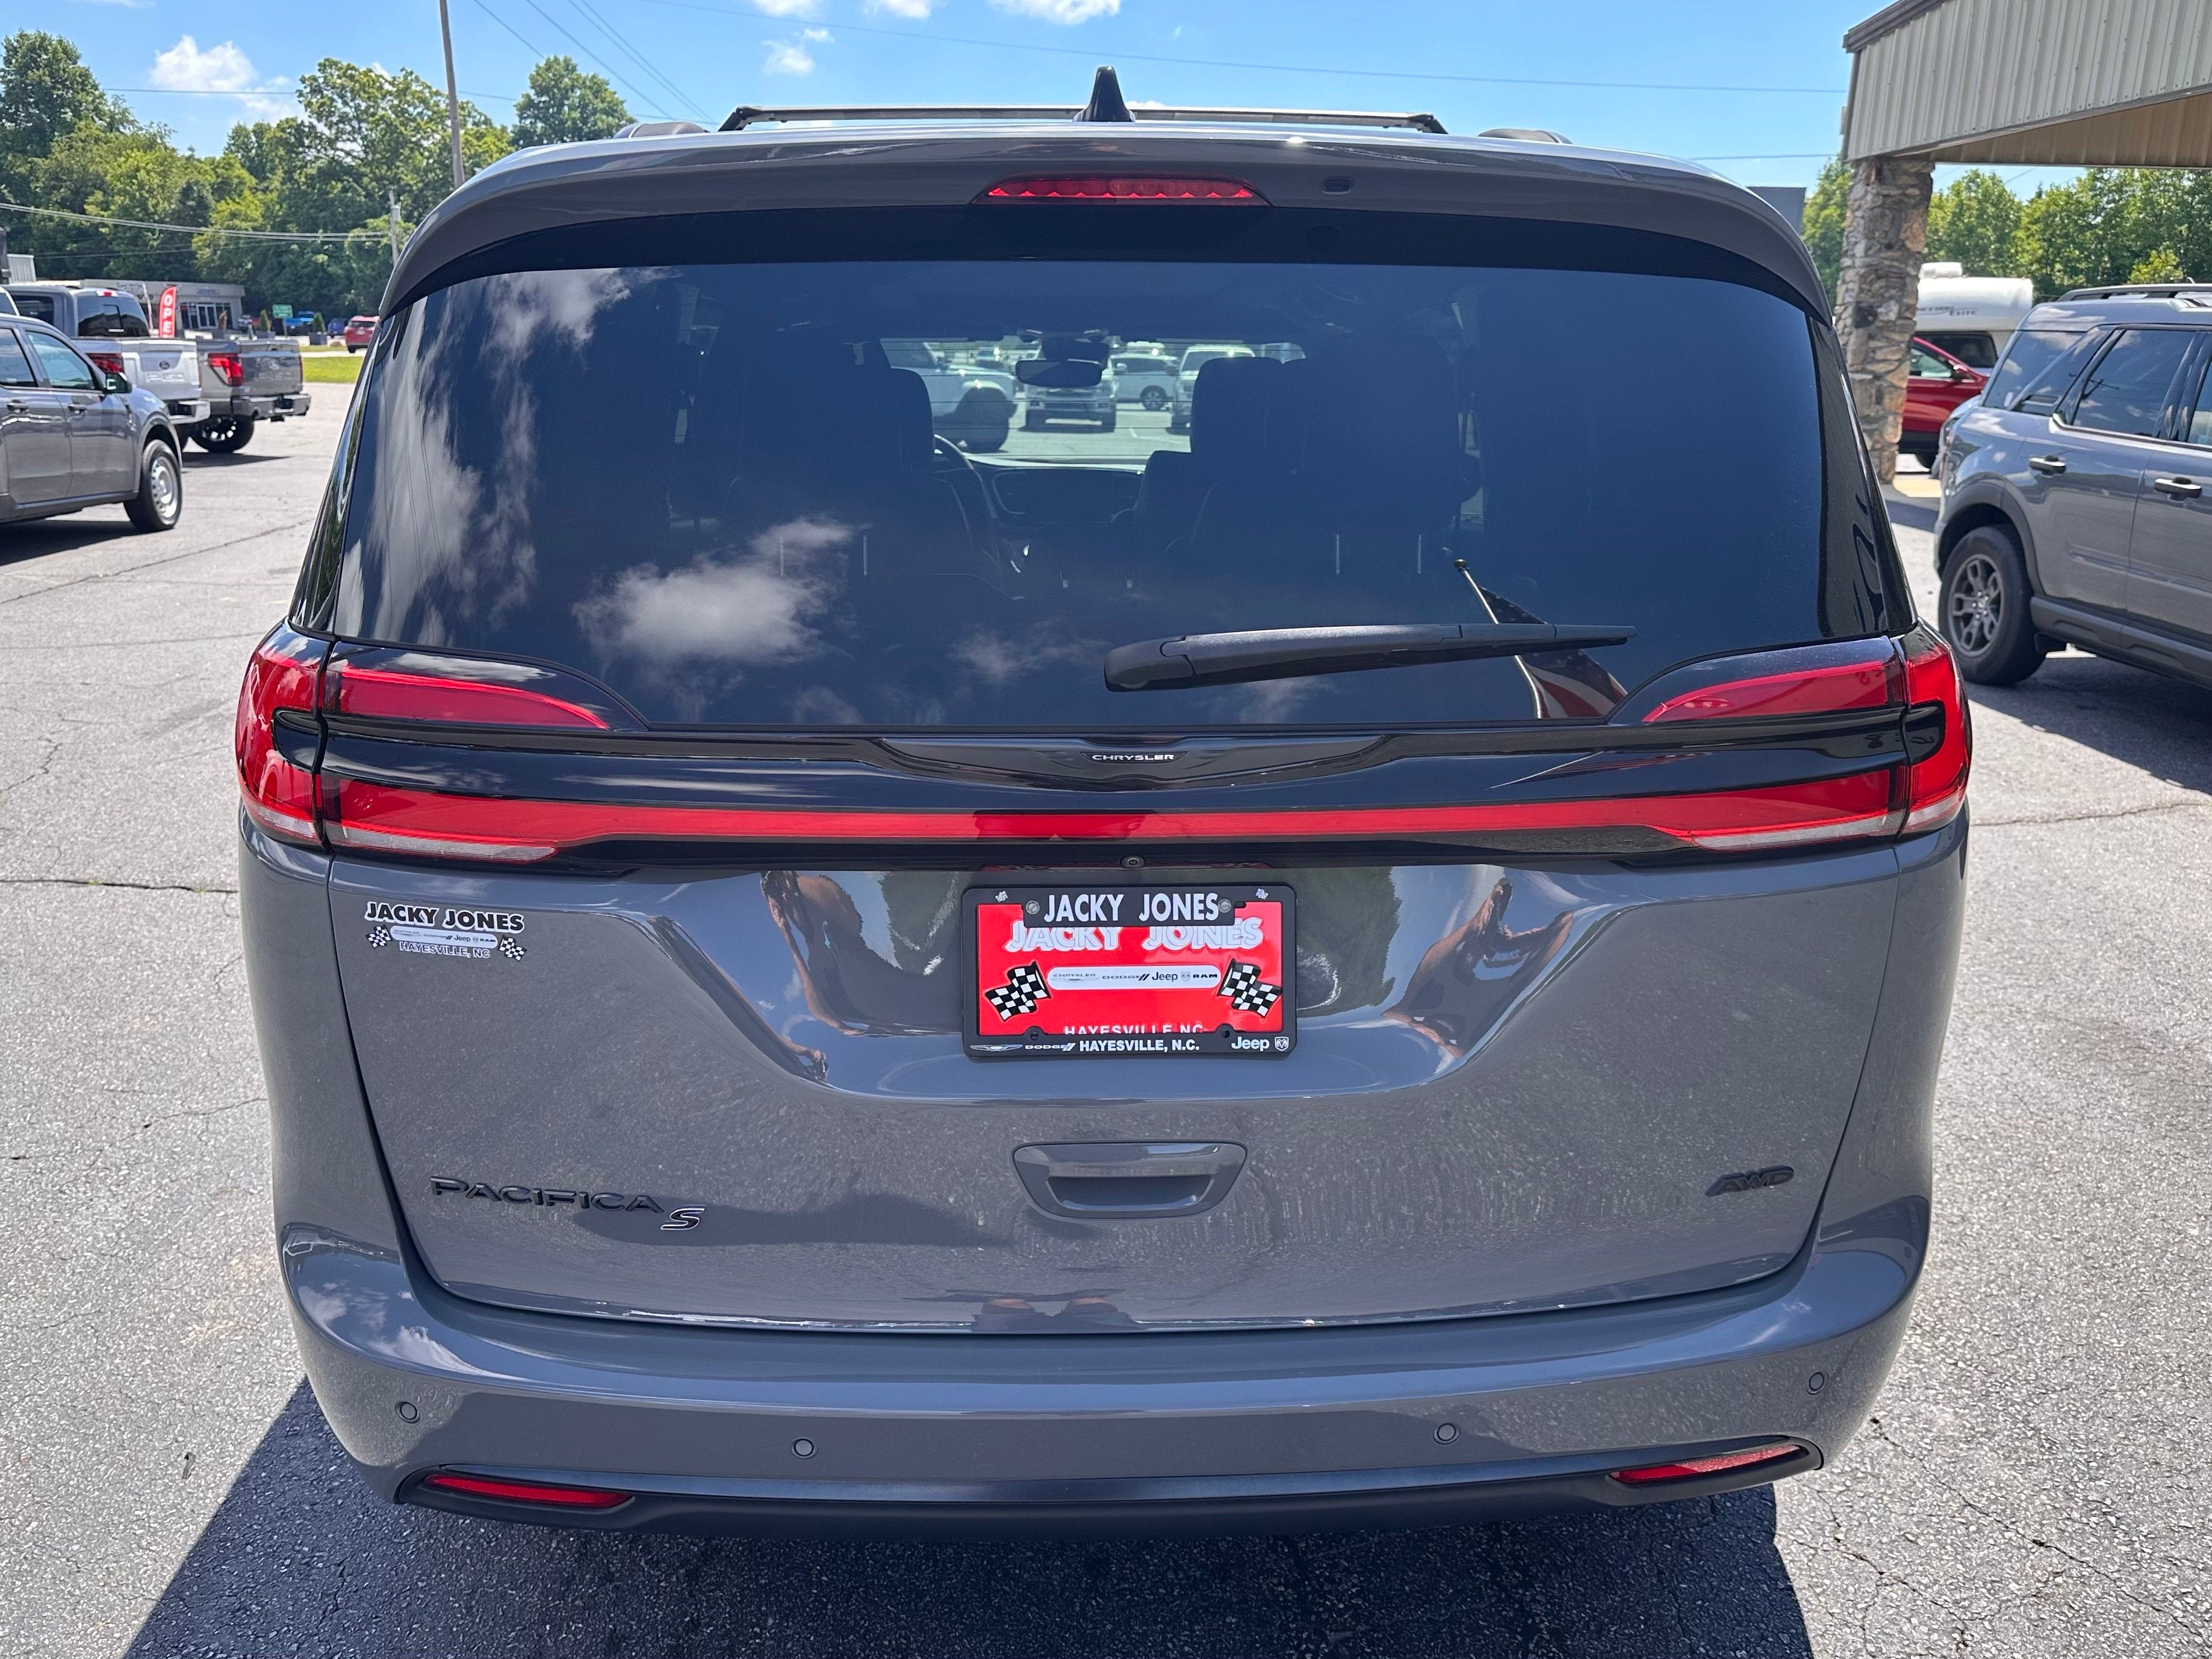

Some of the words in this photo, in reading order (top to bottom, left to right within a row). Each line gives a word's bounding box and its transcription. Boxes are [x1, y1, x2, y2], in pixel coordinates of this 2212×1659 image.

[163, 294, 173, 338] OPE
[364, 901, 440, 926] JACKY
[442, 909, 524, 934] JONES
[1044, 894, 1125, 922] JACKY
[1139, 893, 1219, 922] JONES
[399, 941, 471, 958] HAYESVILLE,
[473, 948, 491, 958] NC
[1005, 919, 1123, 952] JACKY
[1142, 917, 1264, 951] JONES
[1152, 972, 1178, 982] Jeep
[1080, 1040, 1168, 1053] HAYESVILLE,
[1172, 1040, 1200, 1051] N.C.
[1231, 1037, 1270, 1052] Jeep
[1704, 1165, 1795, 1197] AWD
[430, 1176, 665, 1214] PACIFICA
[660, 1206, 706, 1231] S
